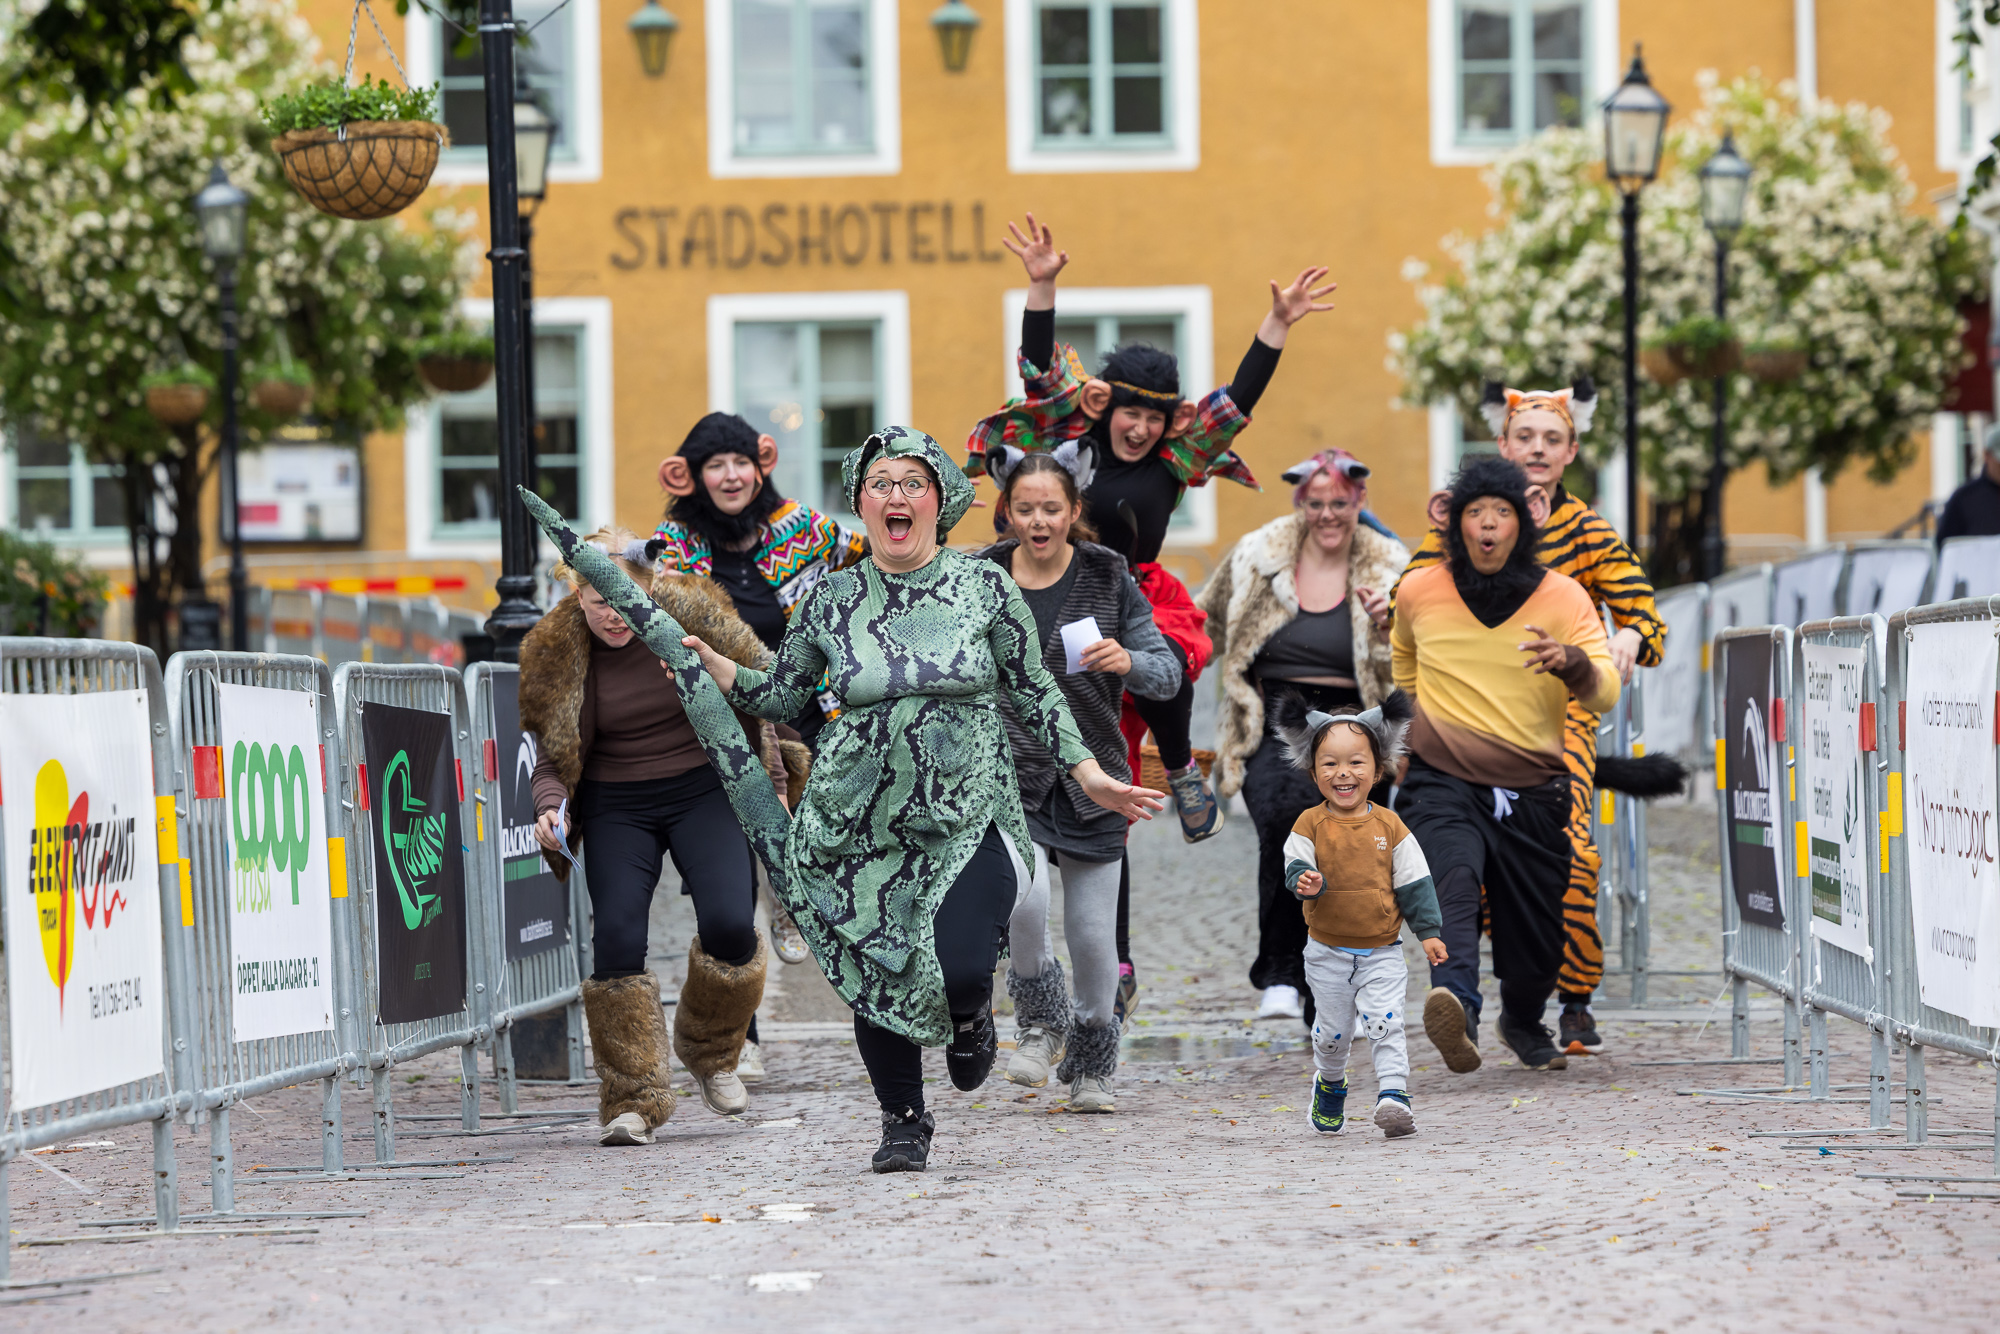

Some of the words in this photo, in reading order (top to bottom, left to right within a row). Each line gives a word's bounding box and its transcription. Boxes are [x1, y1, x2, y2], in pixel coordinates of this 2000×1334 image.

[611, 201, 1004, 270] STADSHOTELL
[1838, 663, 1859, 714] TROSA
[29, 804, 135, 895] ELEKTROTJÄNST
[232, 740, 310, 905] coop
[234, 841, 271, 914] trosa
[237, 954, 260, 994] ÖPPET
[261, 960, 279, 993] ALLA
[279, 958, 304, 991] DAGAR
[303, 957, 309, 988] 8
